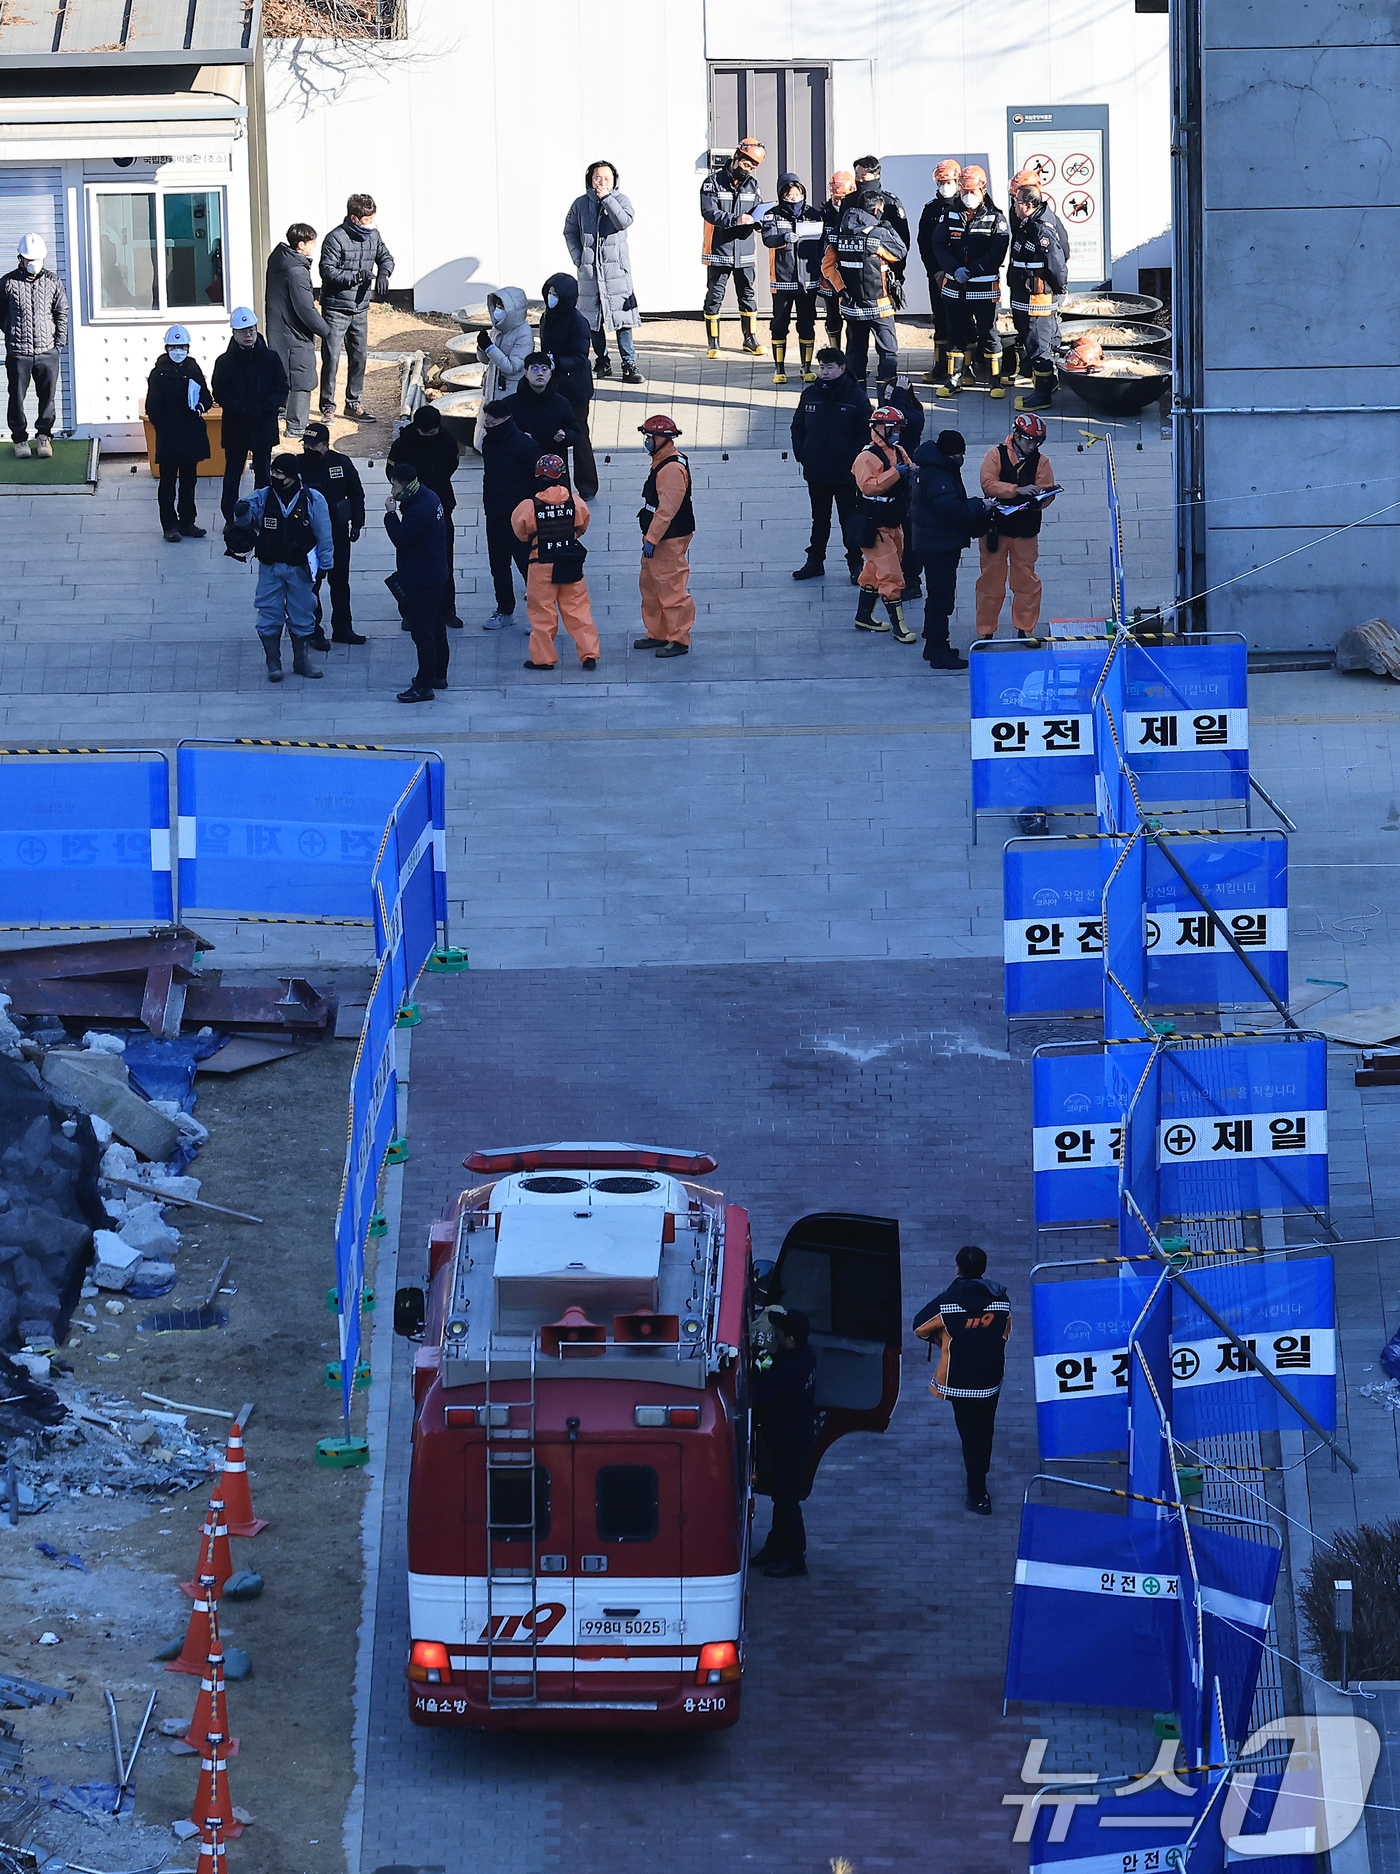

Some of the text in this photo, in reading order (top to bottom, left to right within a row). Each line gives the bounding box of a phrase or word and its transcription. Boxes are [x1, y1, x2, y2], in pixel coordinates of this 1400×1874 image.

[537, 508, 574, 519] 화재조사
[991, 714, 1228, 752] 안전 제일
[1215, 882, 1256, 895] 지킵니다
[1175, 914, 1267, 948] 제일
[1253, 1083, 1297, 1098] 지킵니다
[1211, 1117, 1306, 1153] 제일
[965, 1312, 995, 1329] 119
[1215, 1335, 1311, 1374] 제일
[1101, 1573, 1135, 1593] 안전
[477, 1602, 567, 1643] 119
[625, 1620, 660, 1634] 5025
[415, 1697, 468, 1714] 서울소방
[683, 1697, 726, 1713] 용산10
[1122, 1850, 1159, 1873] 안전
